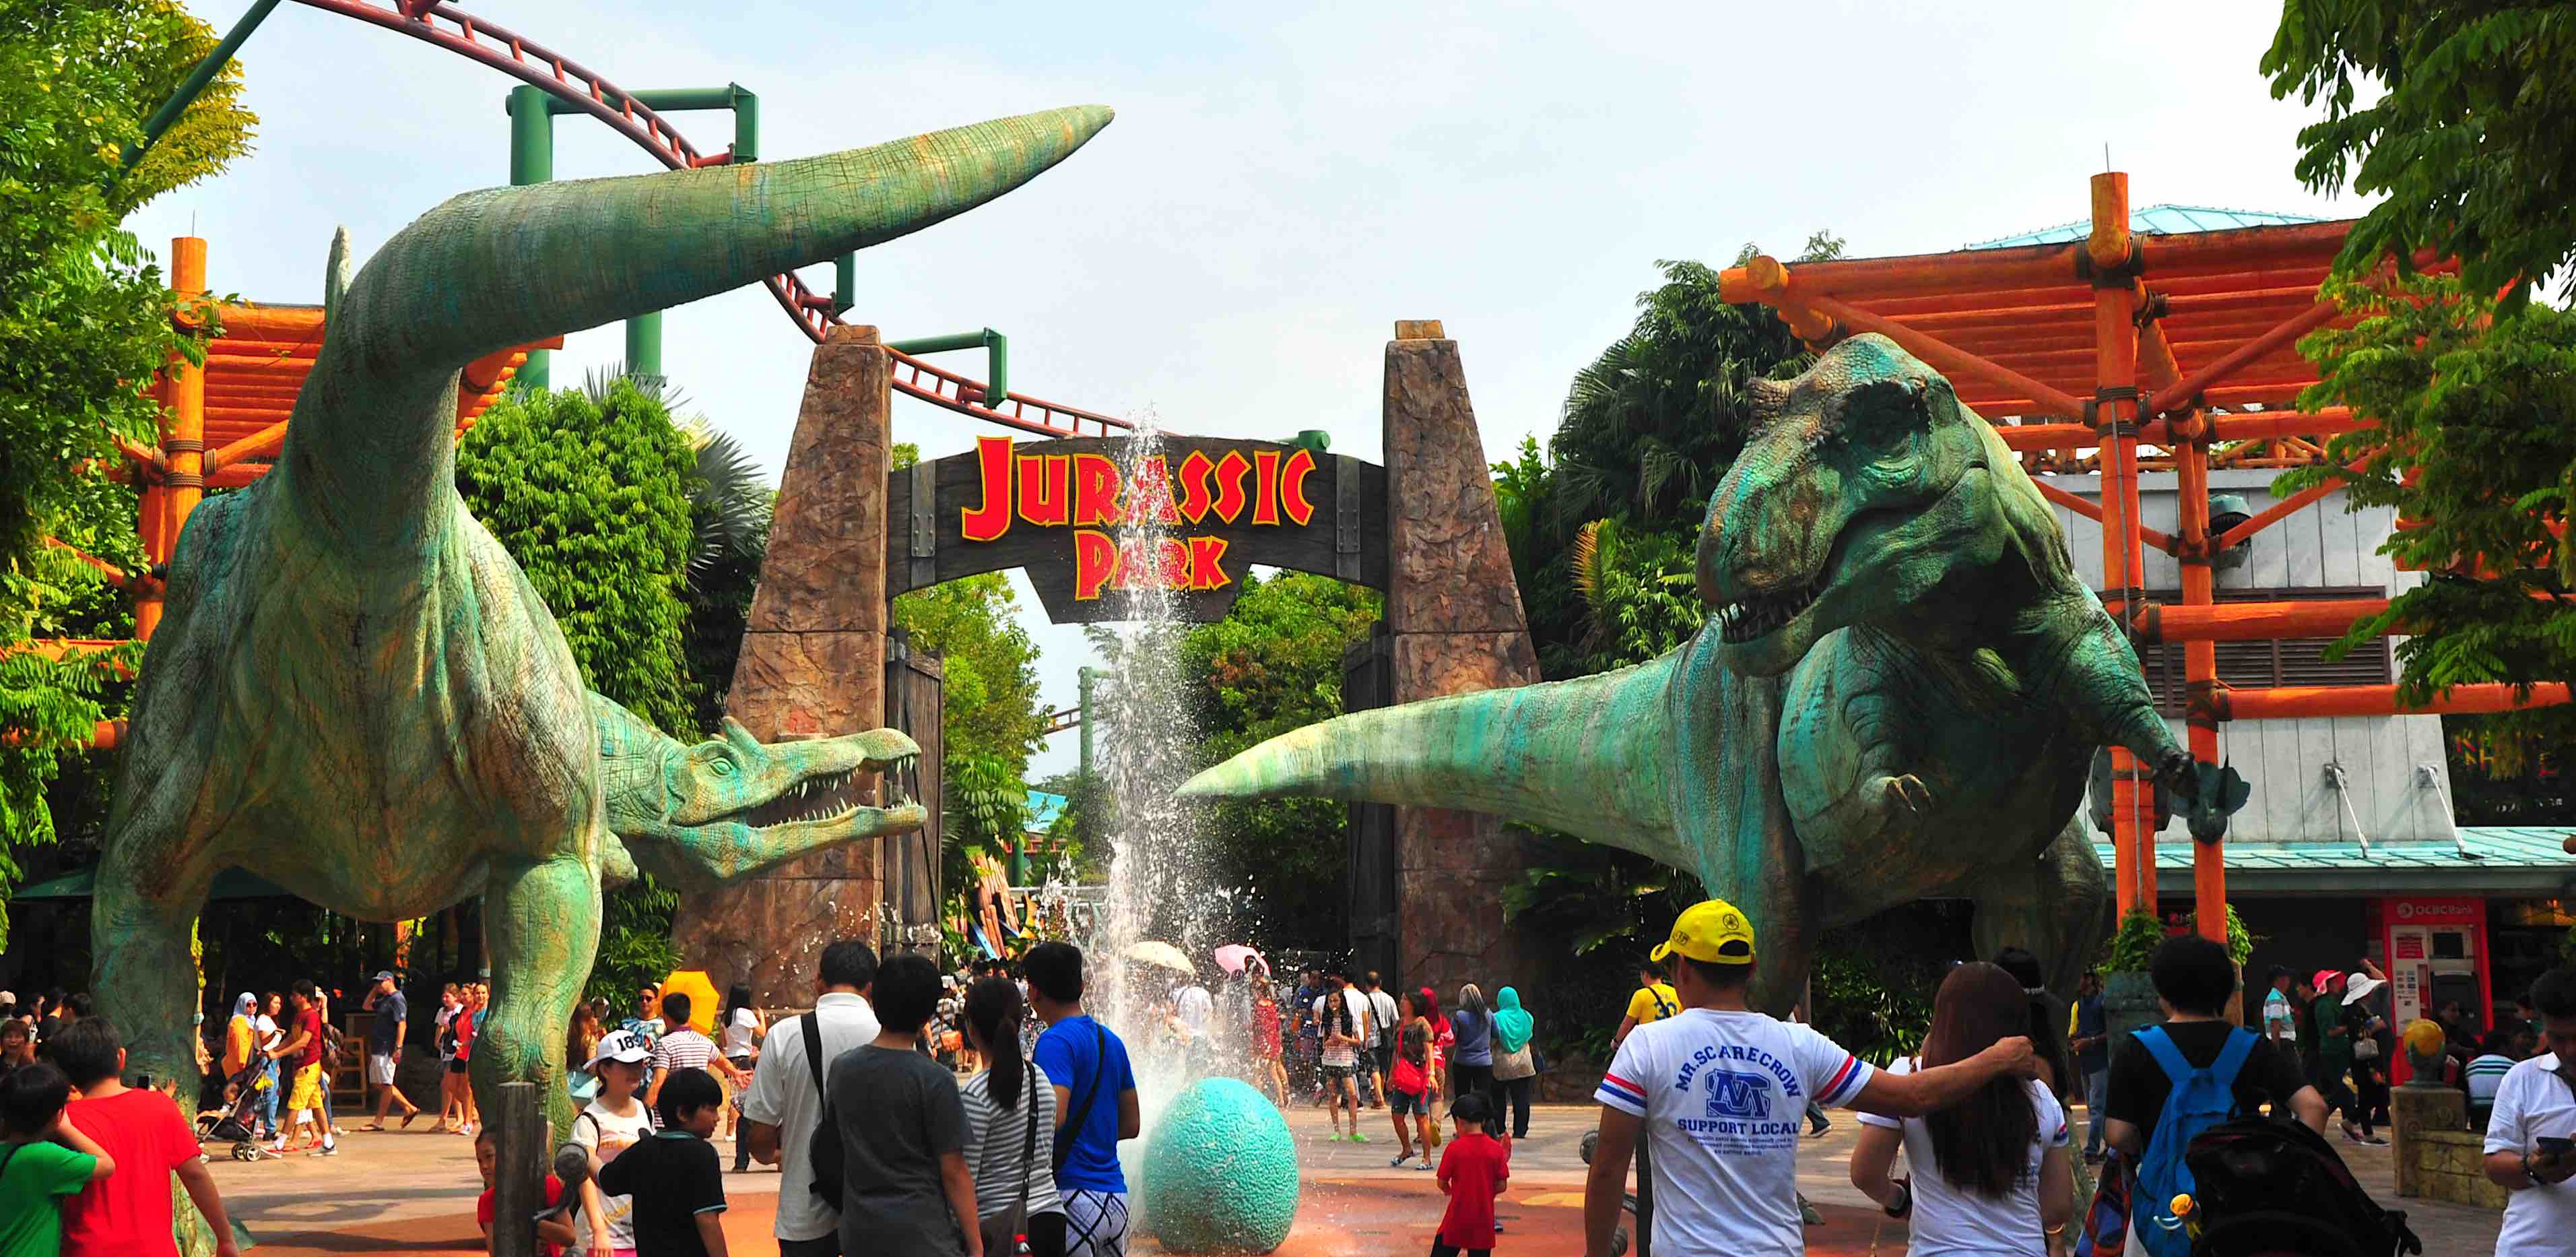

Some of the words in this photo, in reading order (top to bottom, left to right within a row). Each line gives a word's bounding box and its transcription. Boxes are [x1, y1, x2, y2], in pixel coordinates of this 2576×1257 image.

[962, 436, 1316, 541] JURASSIC
[1074, 529, 1231, 601] PARK
[2415, 905, 2447, 915] OCBC
[1678, 1118, 1747, 1134] SUPPORT
[1752, 1122, 1799, 1135] LOCAL
